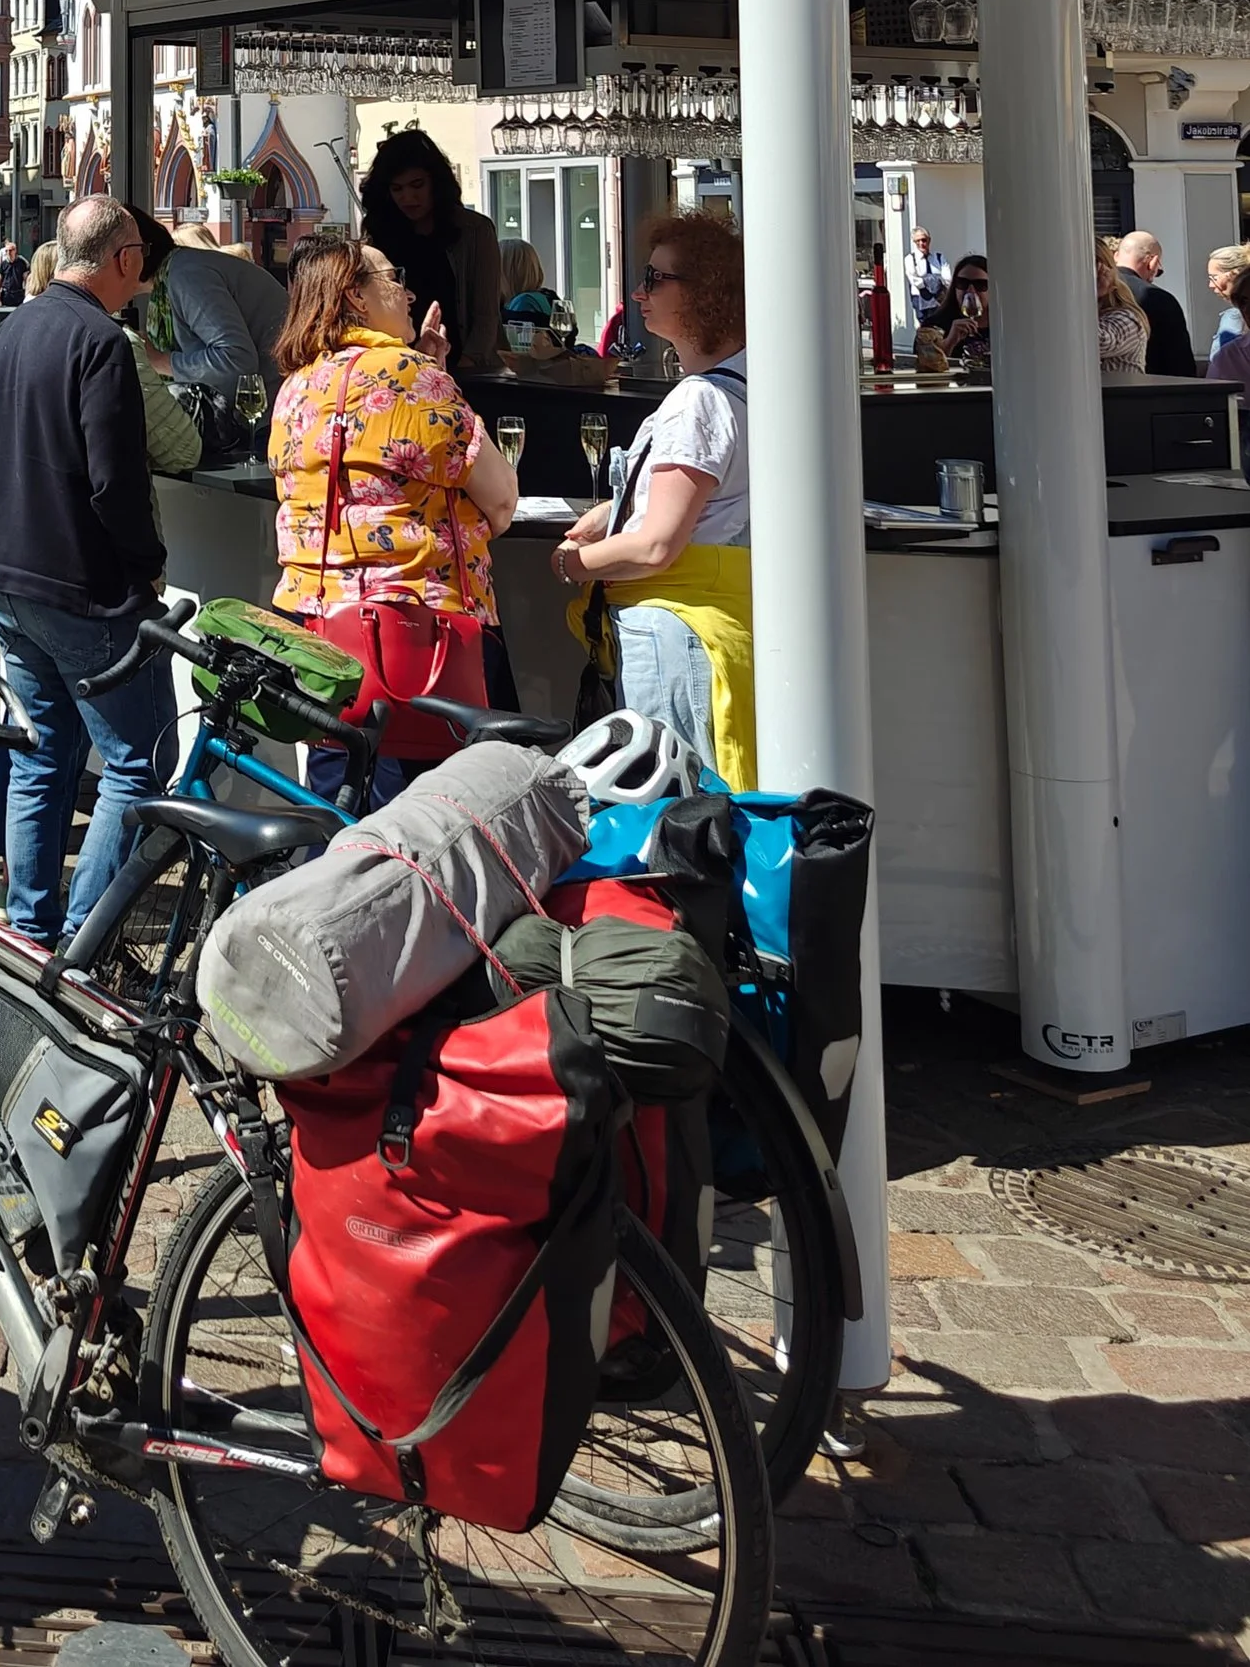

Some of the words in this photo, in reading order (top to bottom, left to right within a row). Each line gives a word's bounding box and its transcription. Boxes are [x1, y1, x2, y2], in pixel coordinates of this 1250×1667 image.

[273, 951, 311, 994] NOMAD
[1061, 1032, 1114, 1047] CTR
[146, 1441, 224, 1464] CROSS
[226, 1448, 308, 1475] MERIDA
